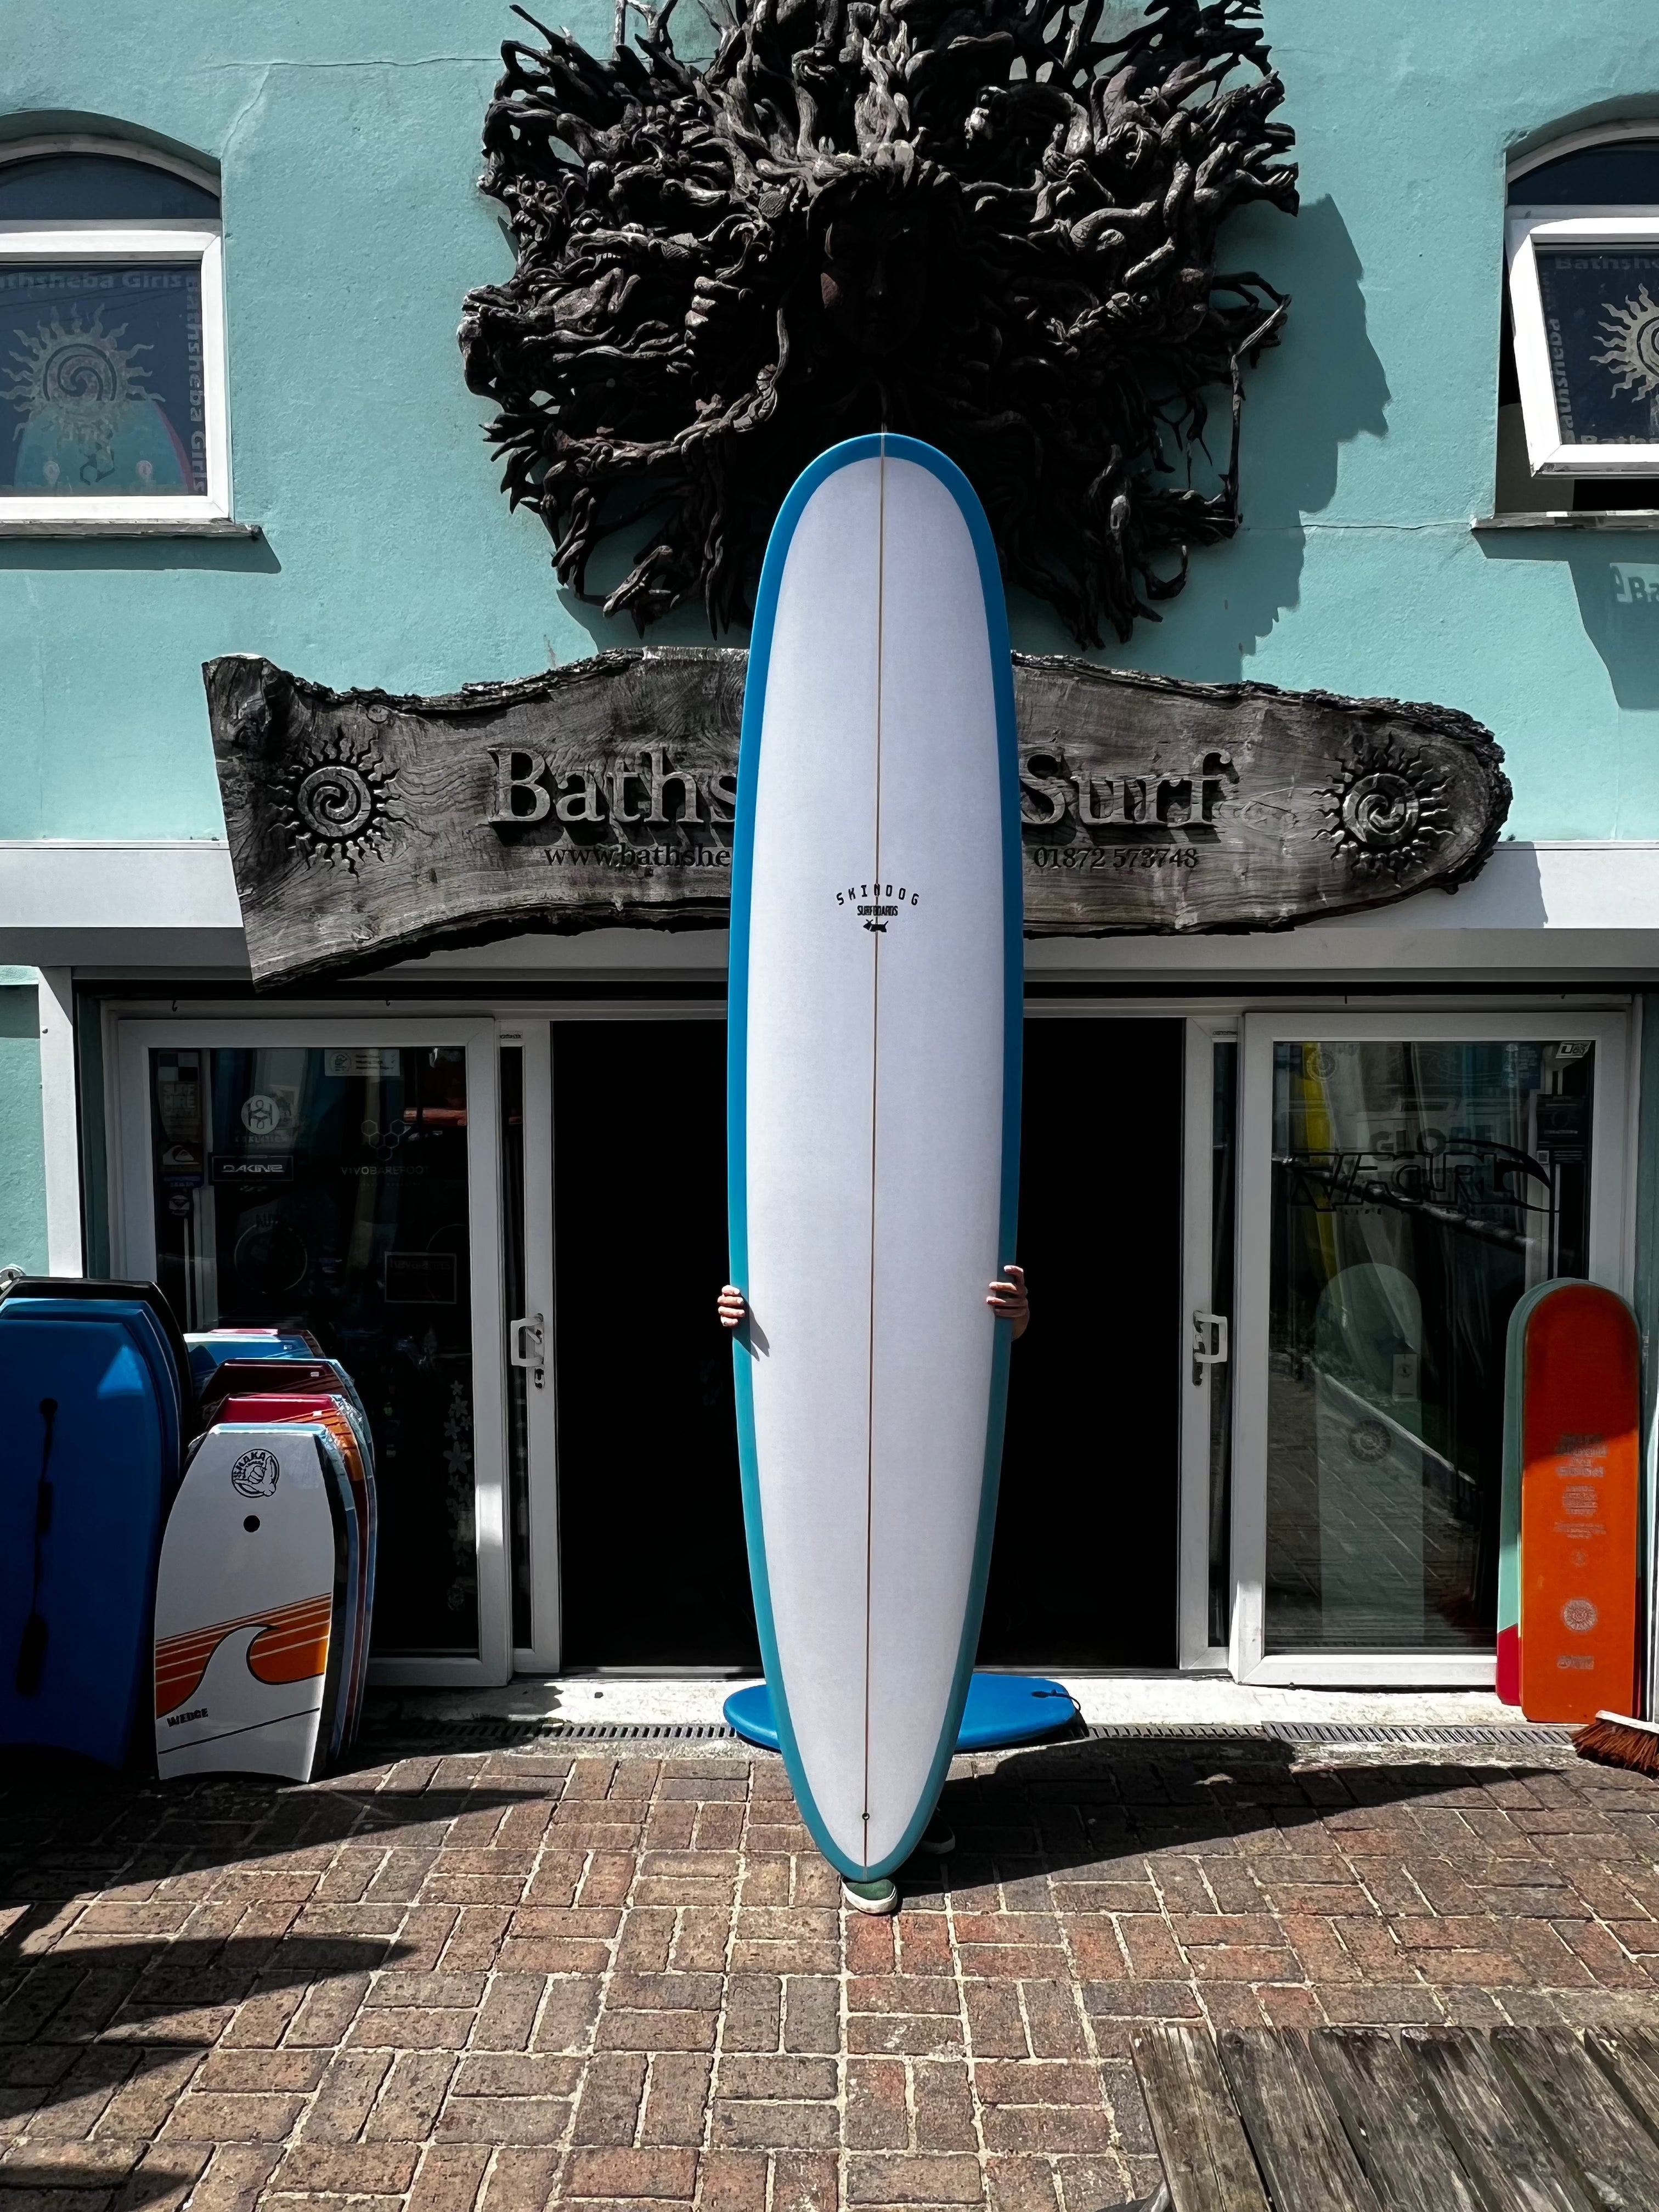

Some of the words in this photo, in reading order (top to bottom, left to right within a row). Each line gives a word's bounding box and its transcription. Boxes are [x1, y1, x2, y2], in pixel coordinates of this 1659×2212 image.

[487, 747, 736, 823] Baths
[1021, 751, 1238, 825] Surf
[1034, 847, 1105, 868] 01872
[1113, 847, 1199, 869] 573748
[836, 883, 919, 906] SKINDOG
[221, 1164, 285, 1173] DAKINE
[166, 1707, 208, 1728] WEDGE
